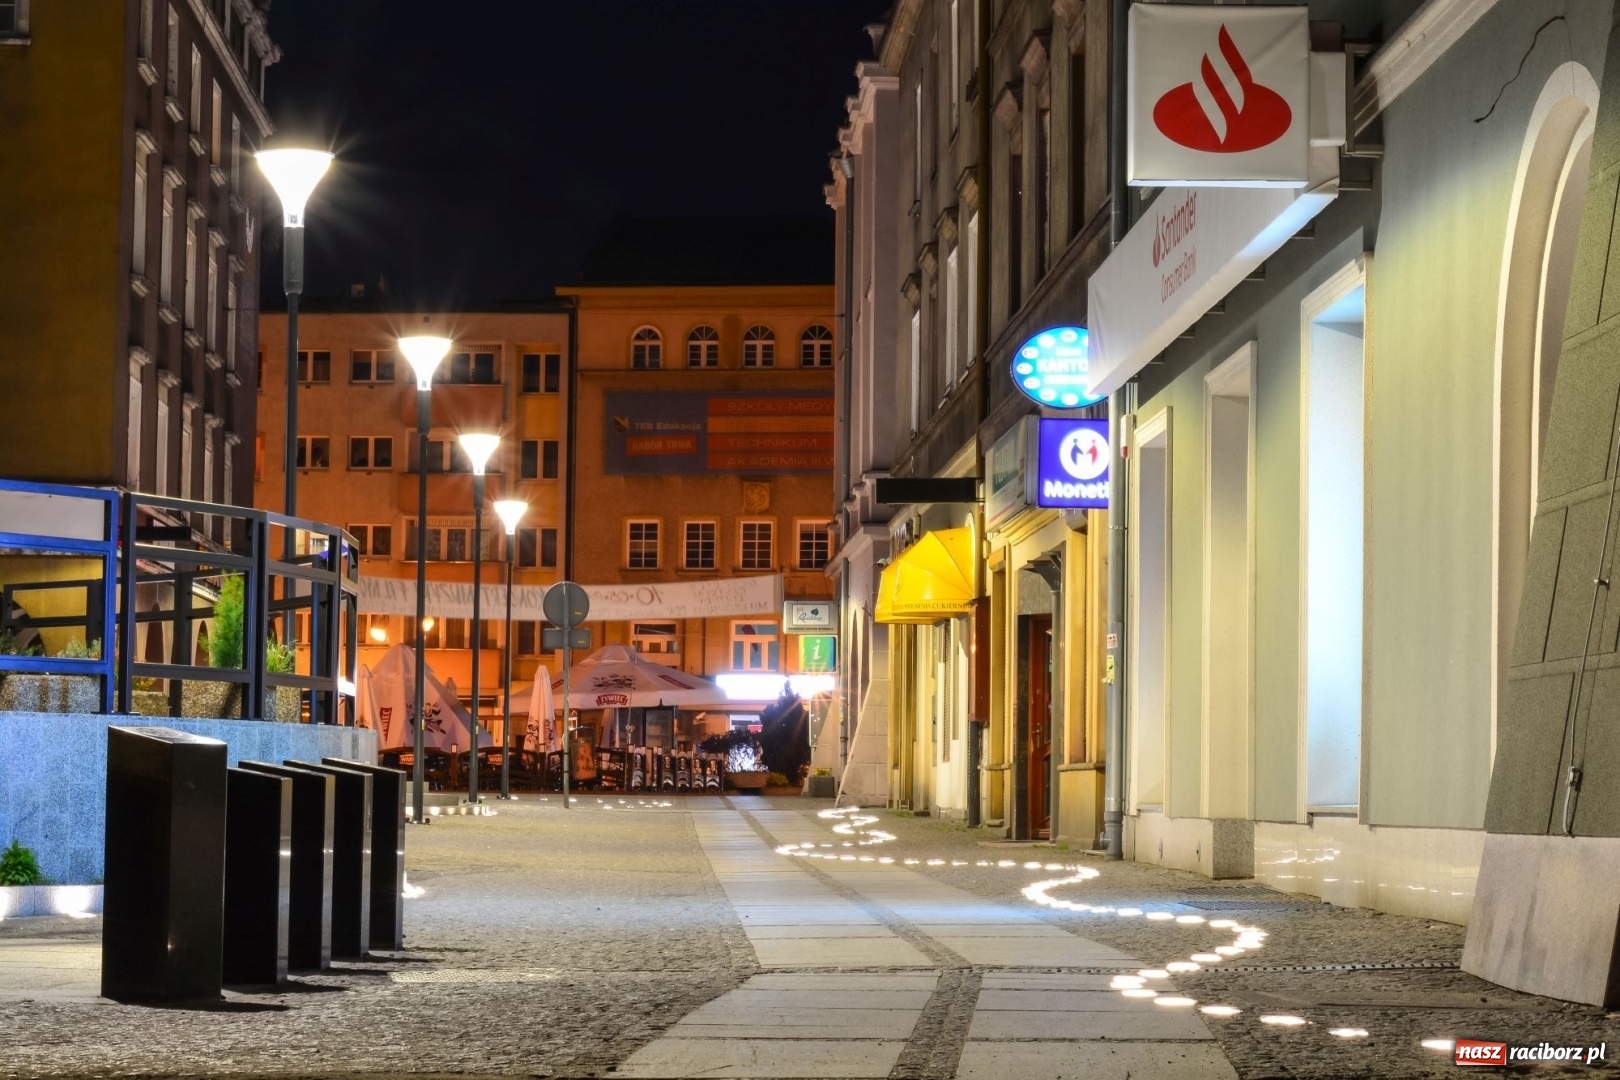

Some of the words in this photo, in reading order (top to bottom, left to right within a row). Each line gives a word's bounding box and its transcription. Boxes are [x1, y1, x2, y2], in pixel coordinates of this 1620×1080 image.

[1161, 188, 1197, 260] Santander
[634, 422, 654, 430] TEB
[656, 421, 702, 431] Edukacja
[666, 440, 692, 450] TRWA
[727, 438, 818, 447] TECHNIKUM
[726, 457, 808, 466] AKADEMIA
